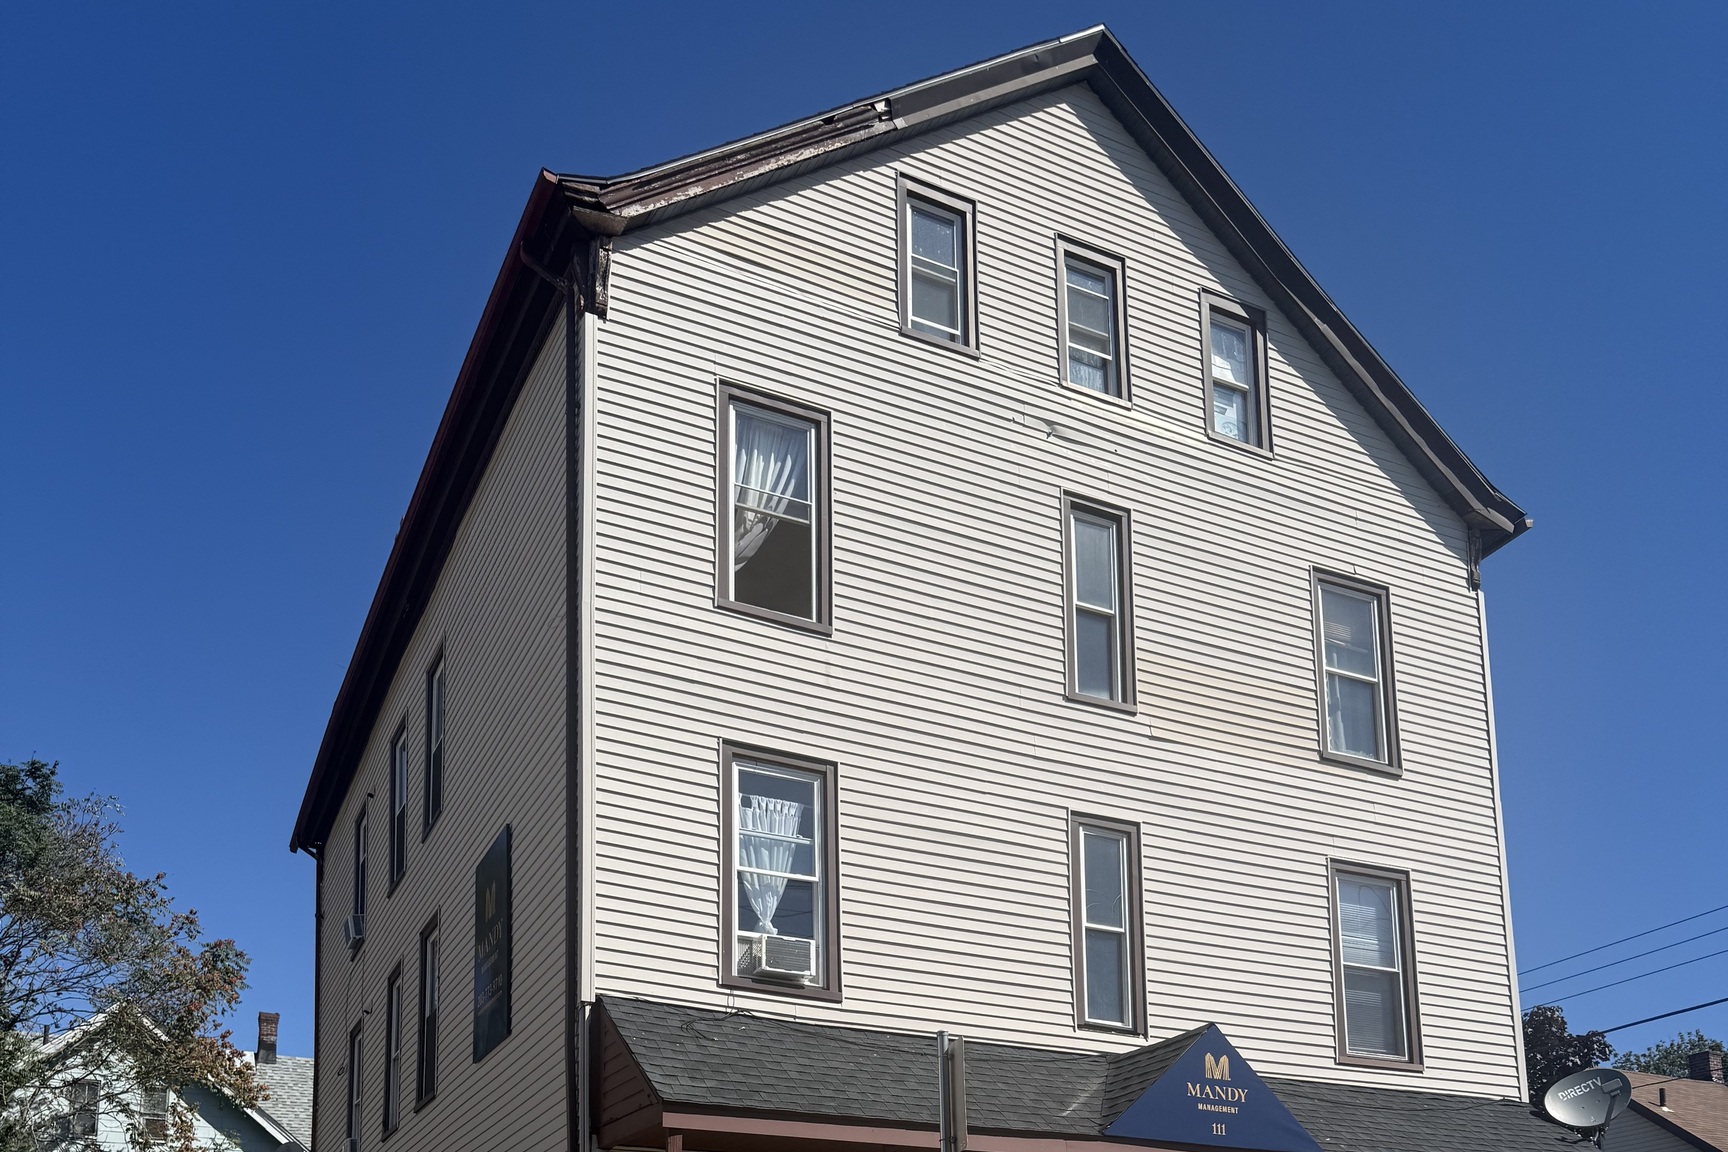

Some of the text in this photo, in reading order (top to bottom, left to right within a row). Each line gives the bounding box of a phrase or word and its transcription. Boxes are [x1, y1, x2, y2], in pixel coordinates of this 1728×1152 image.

[478, 918, 503, 960] MANDY
[1186, 1081, 1248, 1103] MANDY
[1557, 1076, 1602, 1102] DIRECTV
[1198, 1103, 1239, 1114] MANAGEMENT
[1211, 1122, 1226, 1136] 111
